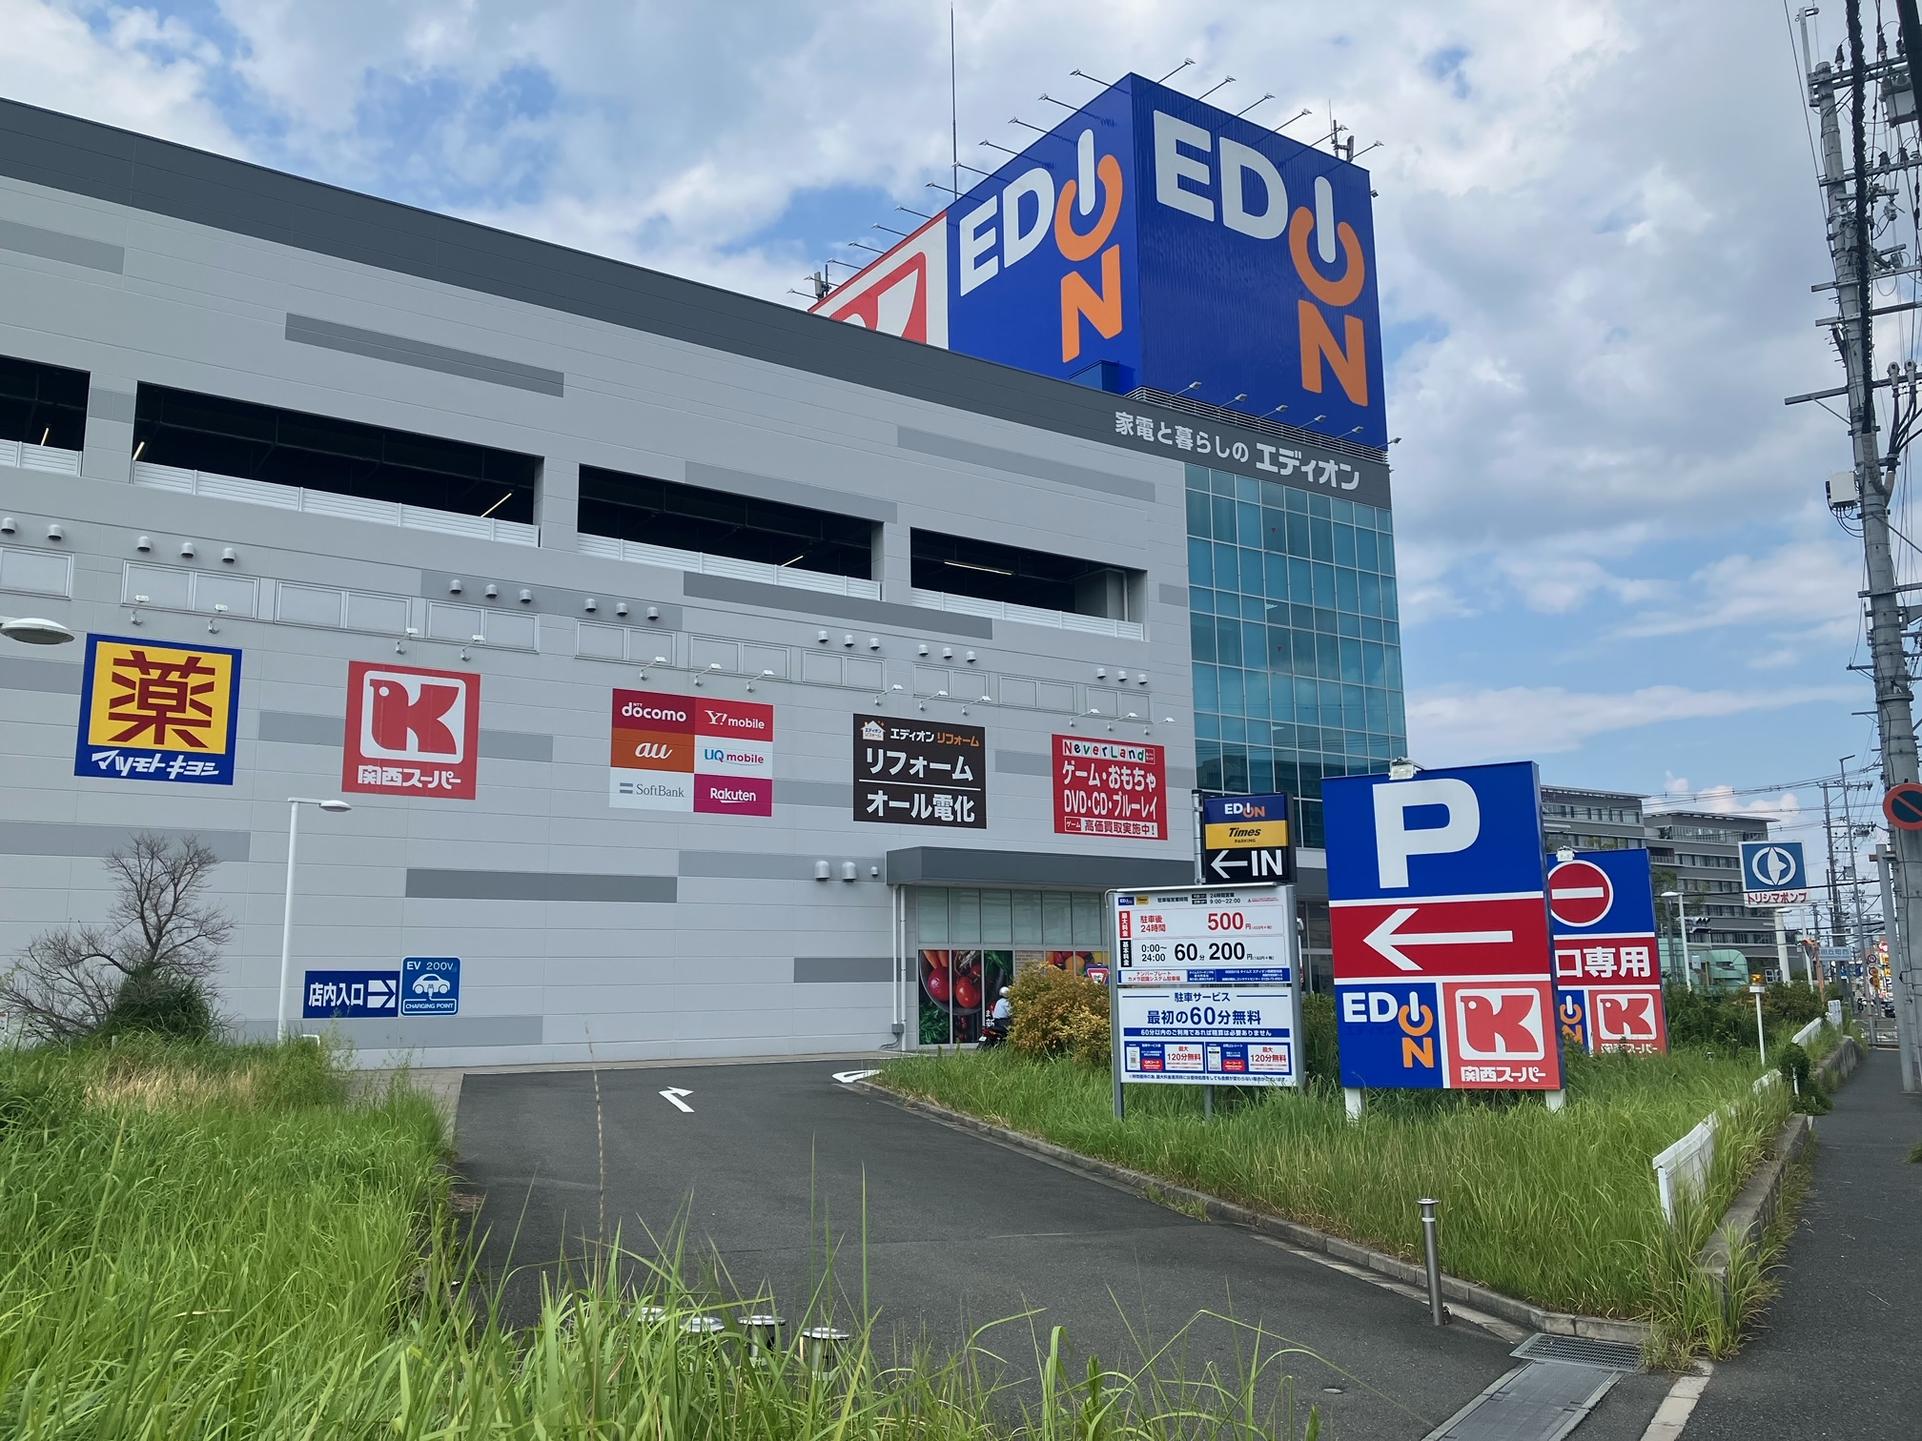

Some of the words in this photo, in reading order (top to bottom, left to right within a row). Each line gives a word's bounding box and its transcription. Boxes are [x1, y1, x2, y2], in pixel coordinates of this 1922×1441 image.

[959, 128, 1123, 363] EDION
[1153, 109, 1368, 407] EDION
[1115, 412, 1249, 462] 家電と暮らしの
[1256, 442, 1360, 490] エディオン
[107, 650, 215, 748] 薬
[622, 702, 686, 722] docomo
[728, 716, 765, 729] mobile
[890, 728, 934, 743] エディオン
[937, 732, 980, 747] リフォーム
[635, 742, 672, 760] au
[704, 749, 724, 762] UQ
[726, 753, 764, 764] mobile
[91, 750, 219, 779] マツモトキヨシ
[866, 747, 973, 781] リフォーム
[358, 765, 461, 789] 関西スーパー
[1063, 760, 1156, 792] ゲーム・おもちゃ
[636, 783, 684, 798] SoftBank
[710, 788, 756, 803] Rakuten
[866, 790, 975, 822] オール電化
[1064, 789, 1157, 819] DVD・CD・ブルーレイ
[1224, 803, 1266, 818] EDION
[1229, 827, 1262, 837] Times
[1372, 778, 1481, 889] P
[1251, 850, 1283, 876] IN
[1747, 892, 1808, 905] トリシマポンプ
[1140, 915, 1163, 923] 駐車後
[1140, 923, 1166, 933] 24時間
[407, 961, 421, 970] EV
[426, 962, 454, 970] 200V
[1142, 953, 1166, 962] 24:00
[309, 982, 364, 1007] 店内入口
[1174, 992, 1231, 1002] 駐車サービス
[1147, 1006, 1261, 1025] 最初の60分無料
[1342, 991, 1435, 1068] EDION
[1167, 1053, 1201, 1061] 120分無料
[1250, 1054, 1287, 1063] 120分無料
[1460, 1066, 1546, 1083] 関西スーパー
